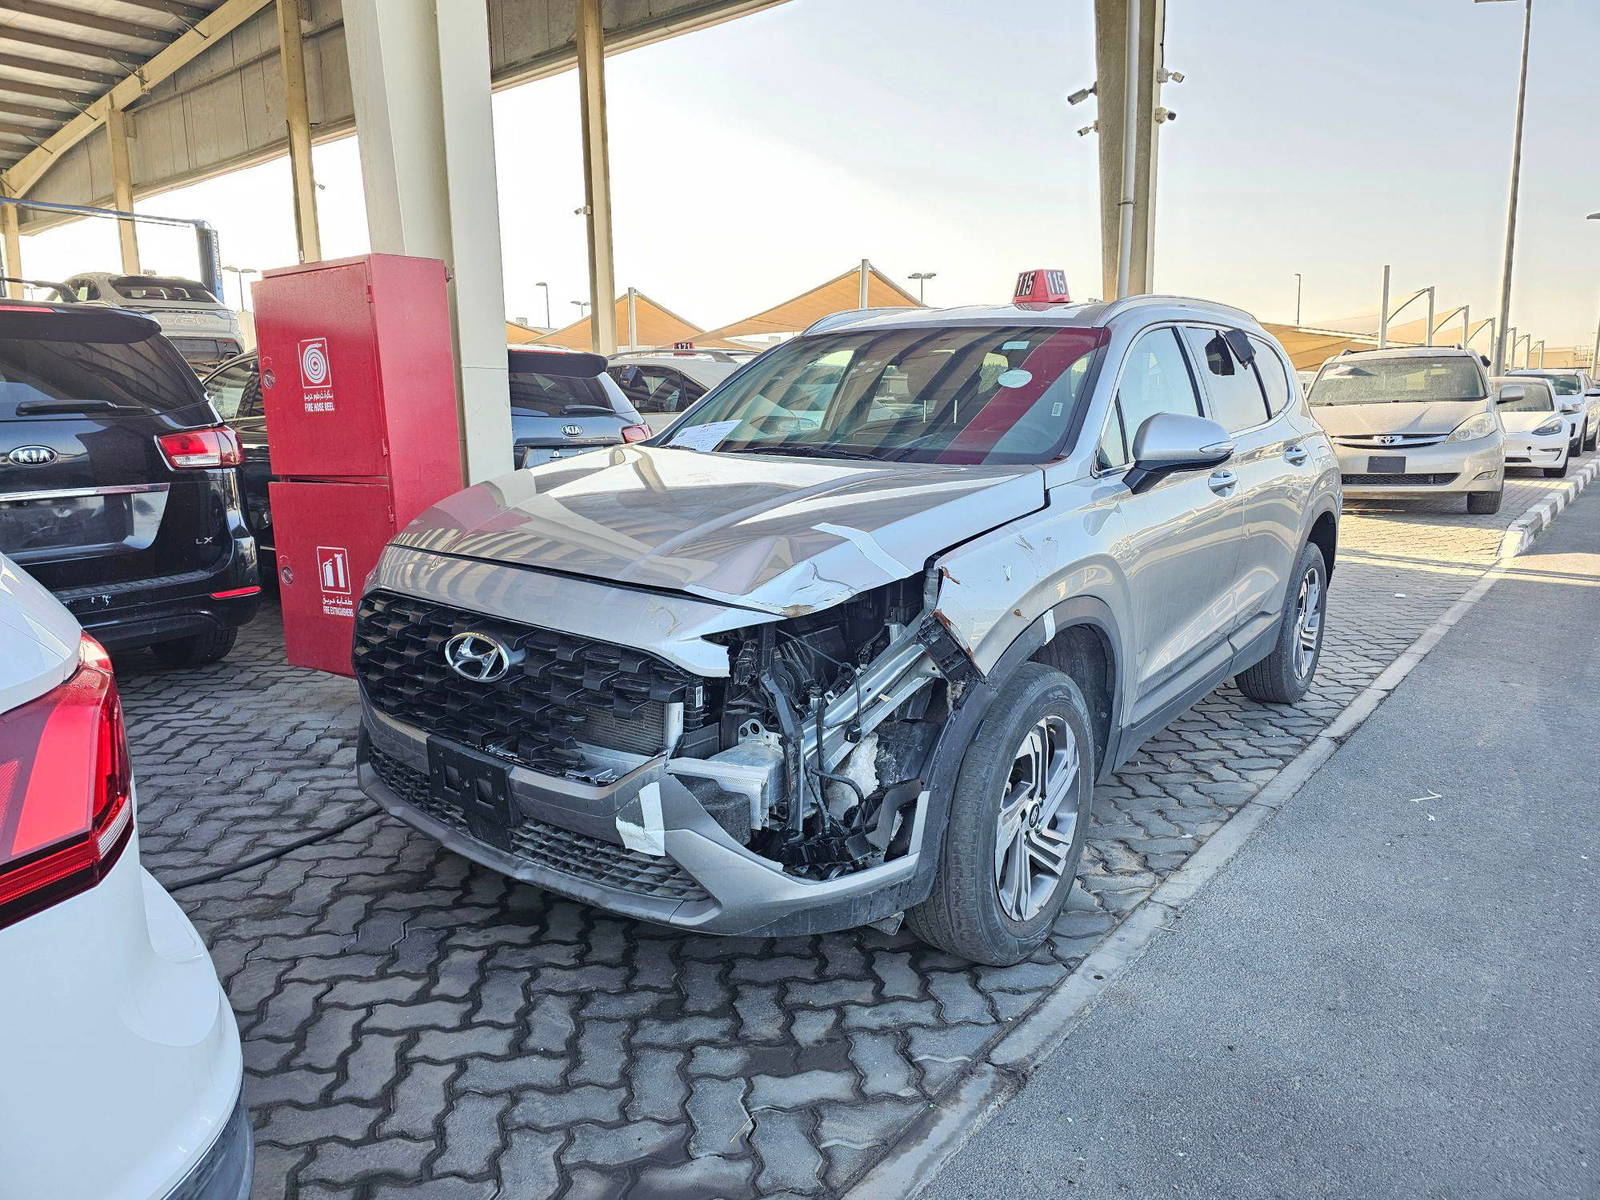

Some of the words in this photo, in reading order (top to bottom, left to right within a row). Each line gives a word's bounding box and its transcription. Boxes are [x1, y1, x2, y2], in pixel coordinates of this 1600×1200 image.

[1016, 271, 1036, 297] 115
[1047, 271, 1066, 294] 115
[305, 402, 313, 412] FIRE
[314, 402, 324, 412] HOSE
[325, 401, 335, 411] REEL
[565, 427, 581, 435] KIA
[17, 449, 51, 462] KIA
[195, 536, 213, 545] LX
